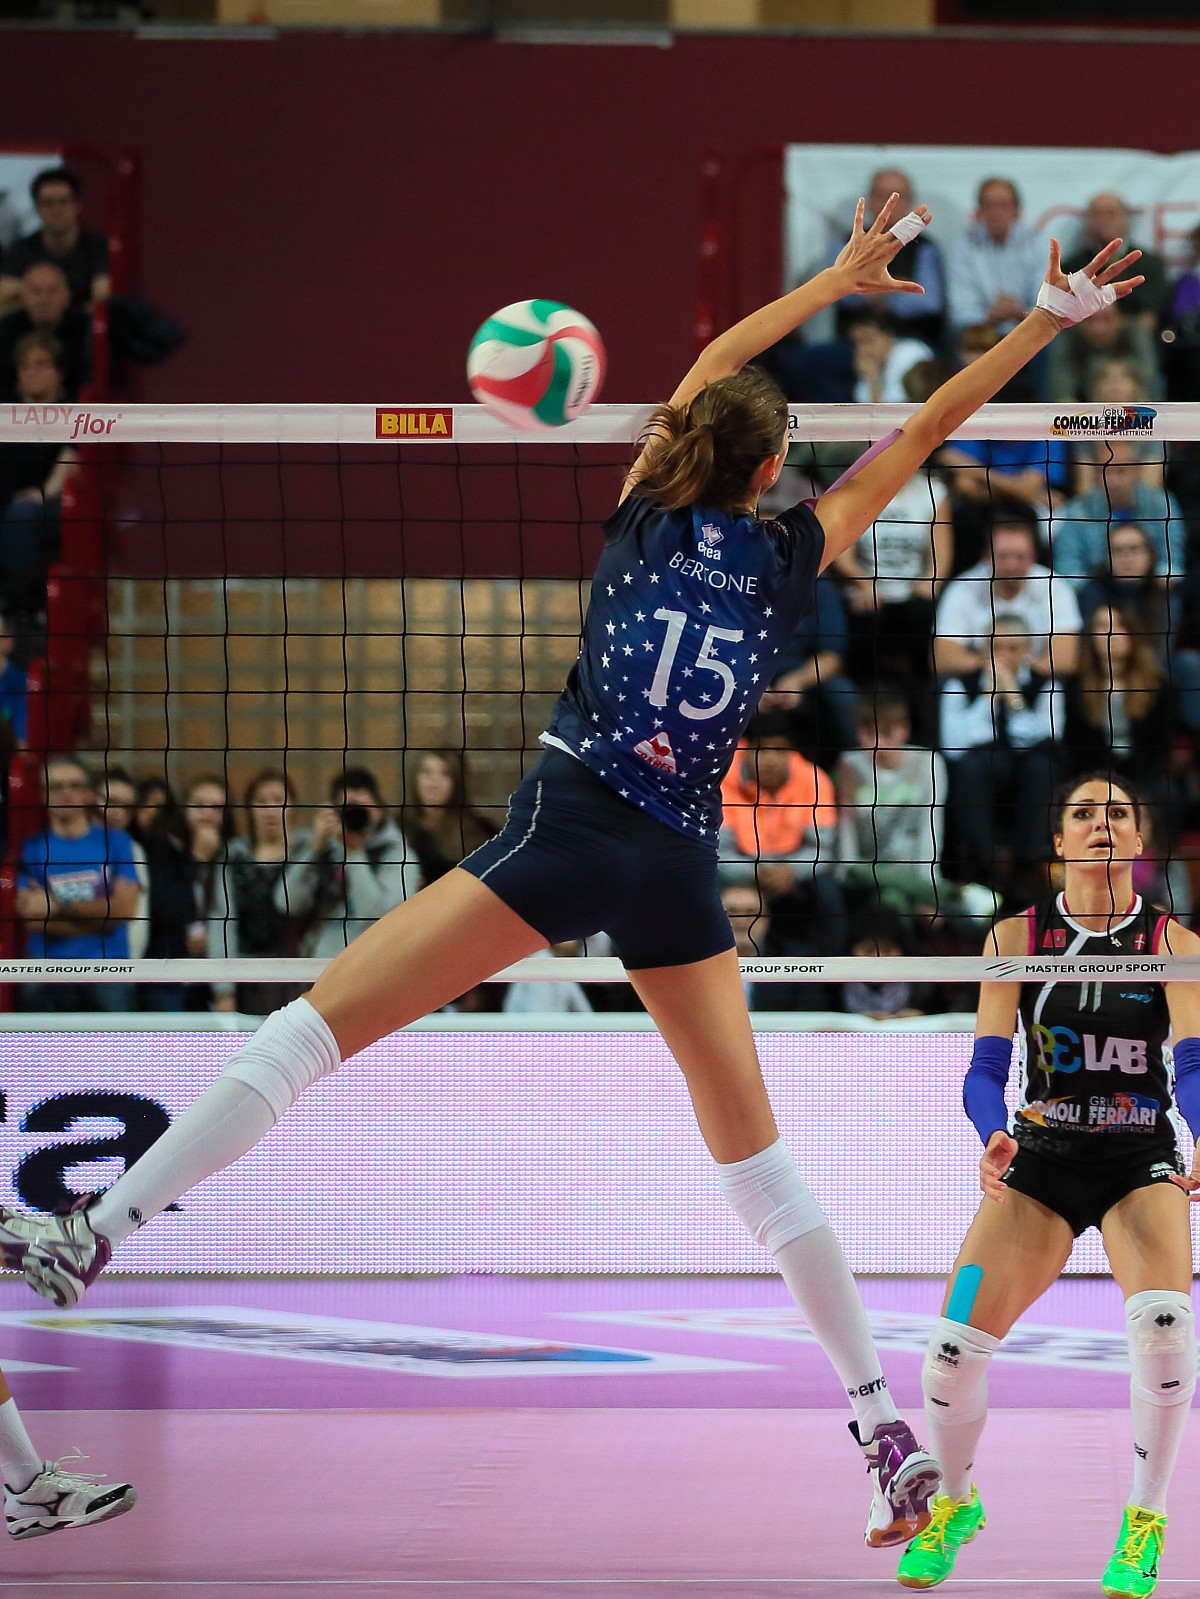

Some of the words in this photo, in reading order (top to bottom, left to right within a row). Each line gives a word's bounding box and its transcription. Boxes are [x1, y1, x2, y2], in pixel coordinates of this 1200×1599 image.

[11, 405, 73, 425] LADY
[381, 413, 448, 434] BILLA
[1103, 416, 1153, 429] FERRARI
[668, 551, 758, 595] BERTONE
[649, 607, 744, 720] 15
[784, 965, 824, 973] SPORT
[1025, 965, 1075, 973] MASTER
[1079, 964, 1123, 973] GROUP
[1125, 963, 1166, 972] SPORT
[1089, 1095, 1138, 1107] GRUPPO
[1088, 1105, 1157, 1126] FERRARI
[858, 1375, 887, 1396] erre
